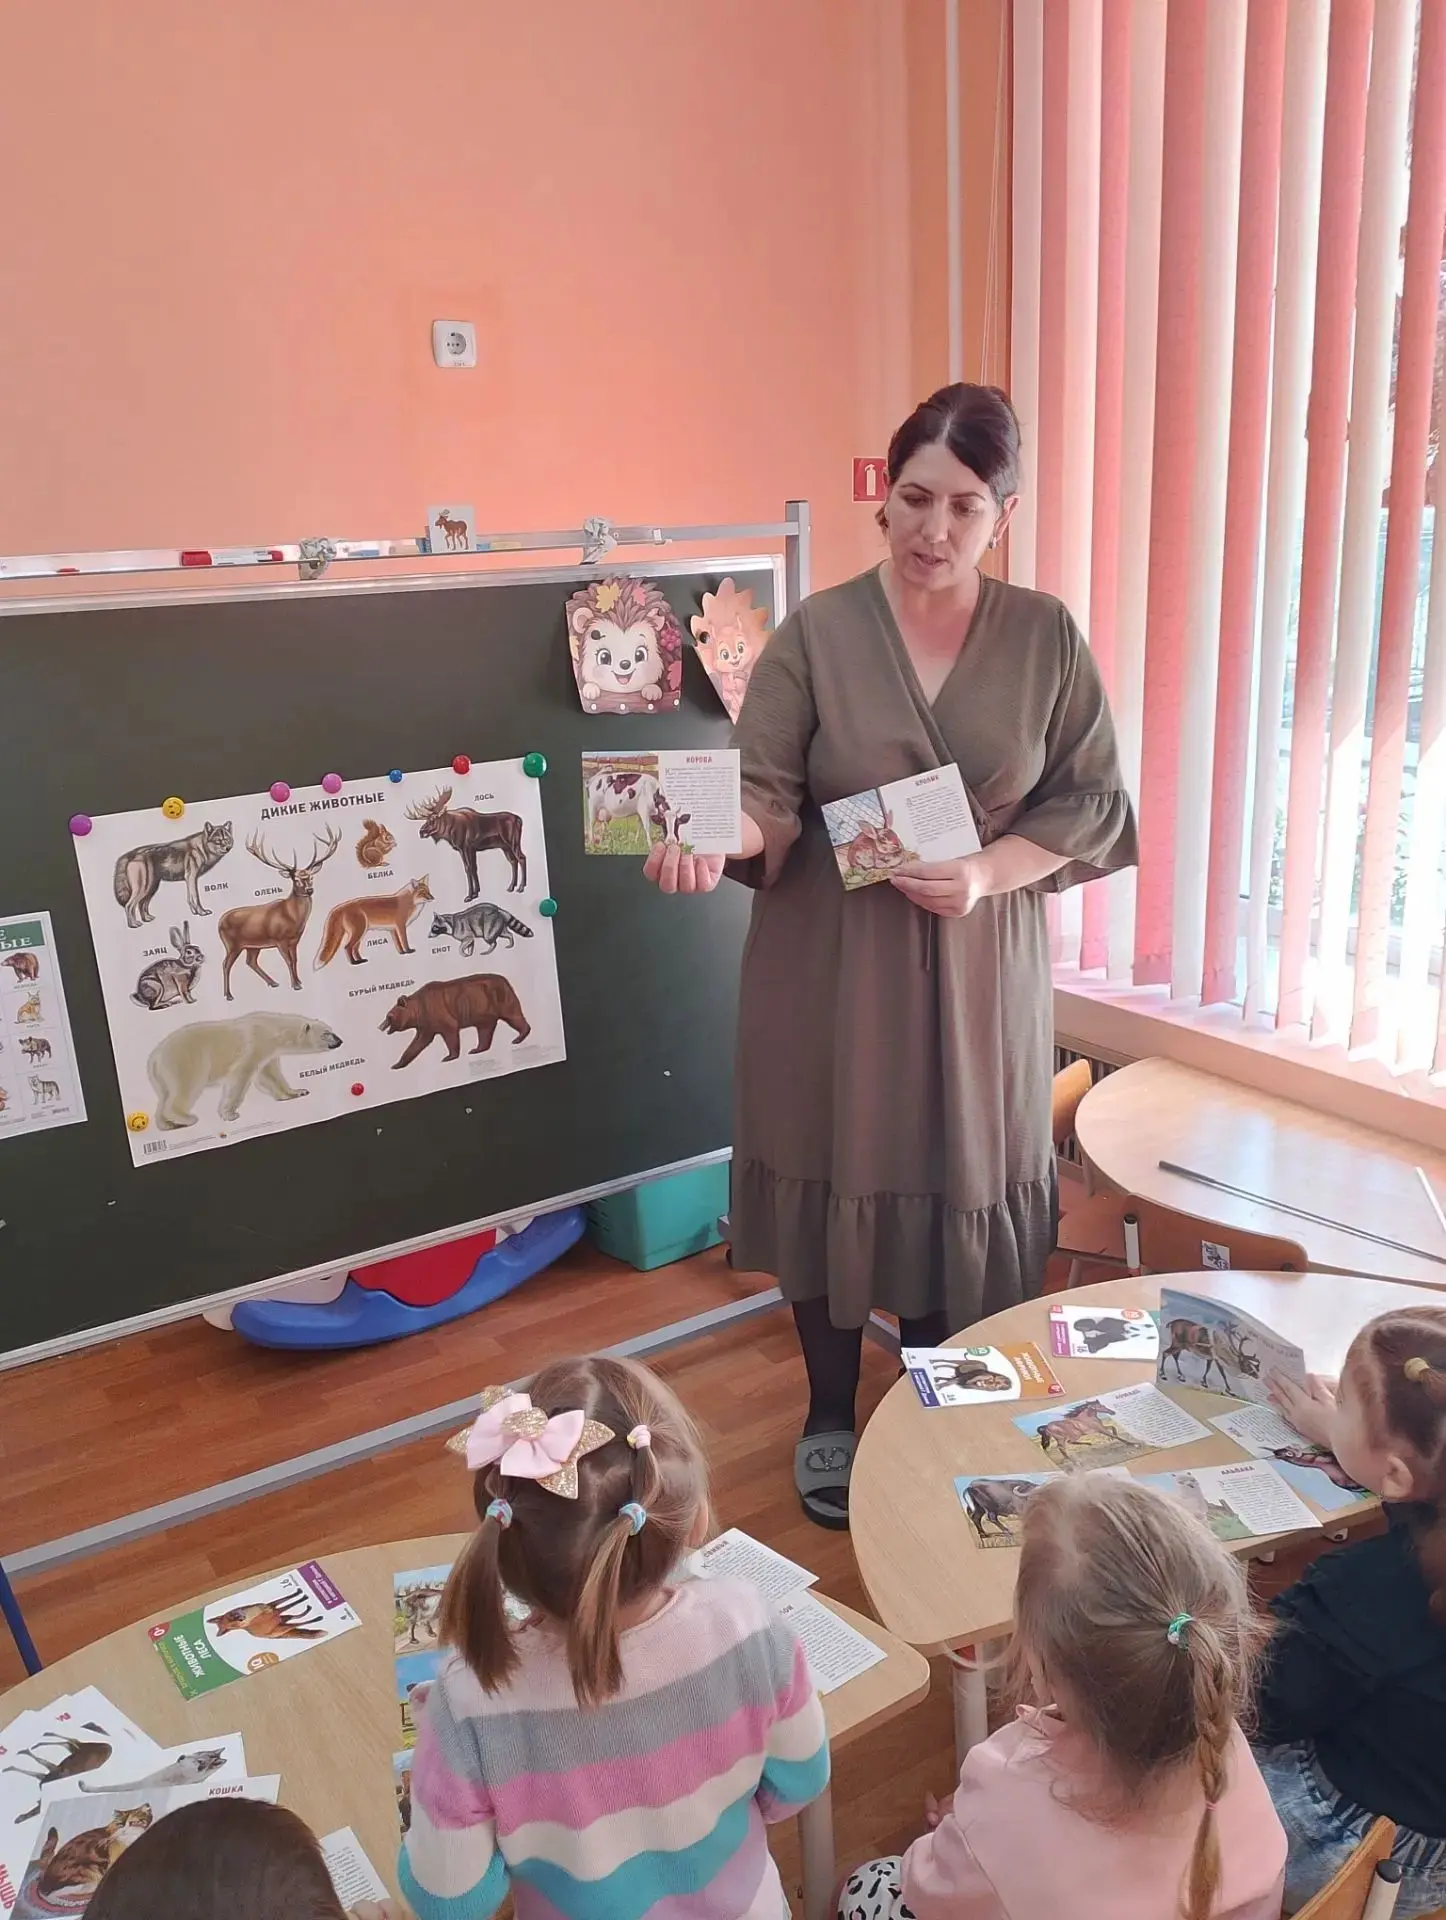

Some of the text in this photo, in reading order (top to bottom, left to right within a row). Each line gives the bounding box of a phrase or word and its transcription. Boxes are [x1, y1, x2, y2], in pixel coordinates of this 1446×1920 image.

[474, 793, 494, 802] ЛОСЬ
[261, 792, 385, 820] ДИКИЕ ЖИВОТНЫЕ
[367, 870, 394, 880] БЕЛКА
[204, 882, 229, 893] ВОЛК
[254, 887, 283, 897] ОЛЕНЬ
[366, 938, 389, 947] ЛИСА
[143, 946, 168, 957] ЗАЯЦ
[431, 945, 451, 955] ЕНОТ
[348, 979, 415, 997] БУРЫЙ МЕДВЕДЬ
[299, 1057, 366, 1079] БЕЛЫЙ МЕДВЕДЬ
[193, 1638, 213, 1660] ЛЕСА
[173, 1634, 207, 1678] ЖИВОТНЫЕ
[208, 1785, 244, 1796] КОШКА
